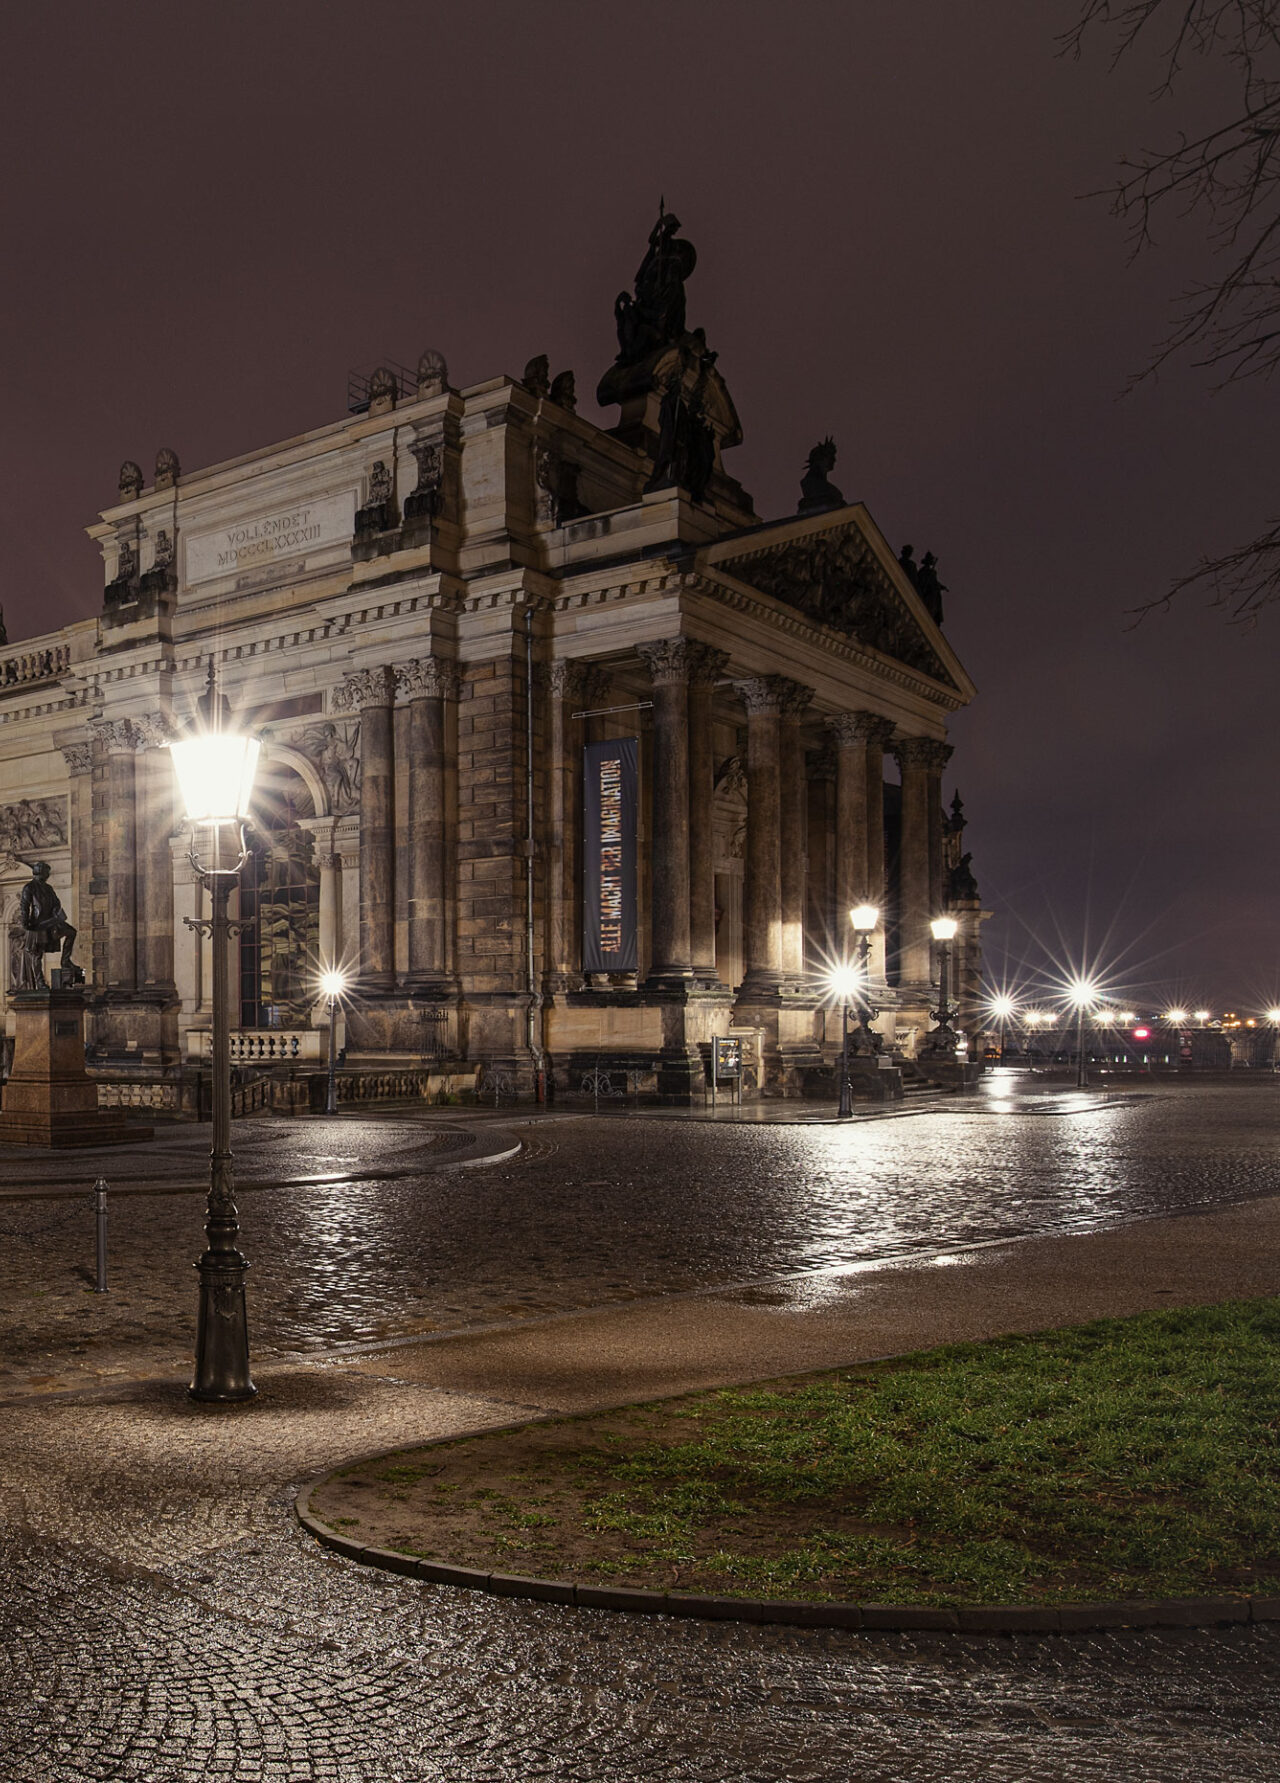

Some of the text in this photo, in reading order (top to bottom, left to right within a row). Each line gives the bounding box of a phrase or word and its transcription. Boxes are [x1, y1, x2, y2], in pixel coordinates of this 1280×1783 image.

[218, 524, 321, 566] MDCCCLXXXXIII
[227, 510, 310, 545] VOLLENDET
[600, 759, 622, 953] ALLE MACHT DER IMAGINATION
